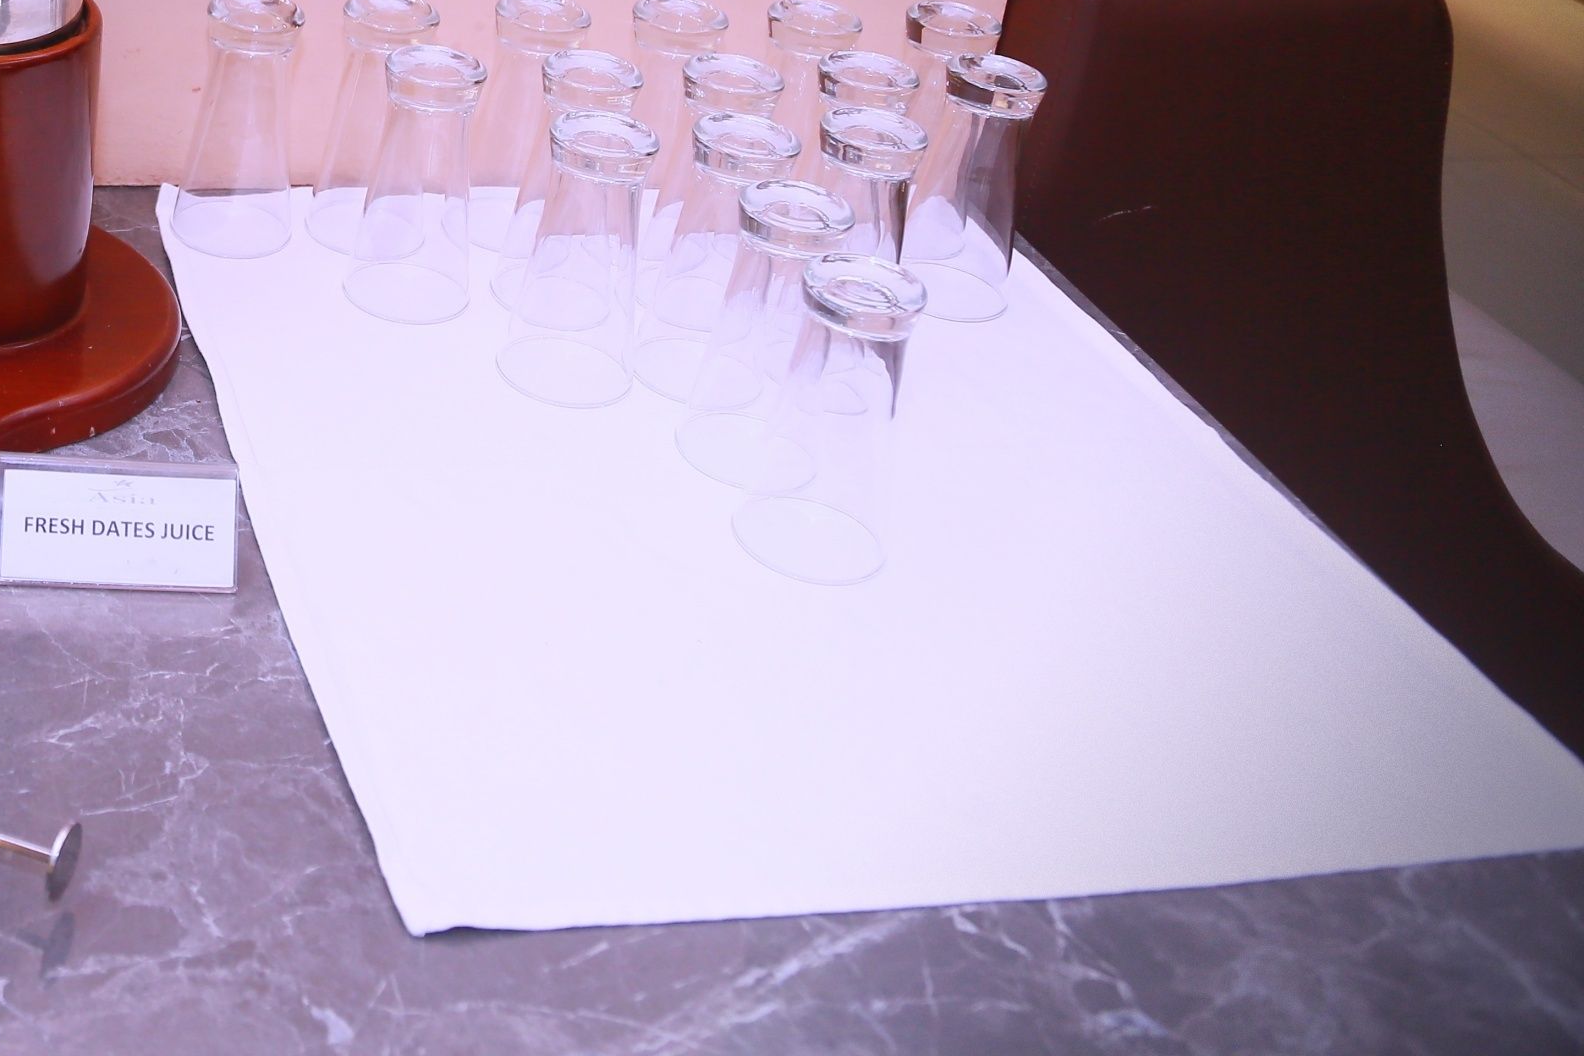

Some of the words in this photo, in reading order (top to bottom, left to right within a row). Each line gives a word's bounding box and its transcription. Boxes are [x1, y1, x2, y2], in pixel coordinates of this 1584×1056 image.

[24, 516, 84, 536] FRESH
[92, 520, 155, 538] DATES
[161, 523, 215, 542] JUICE
